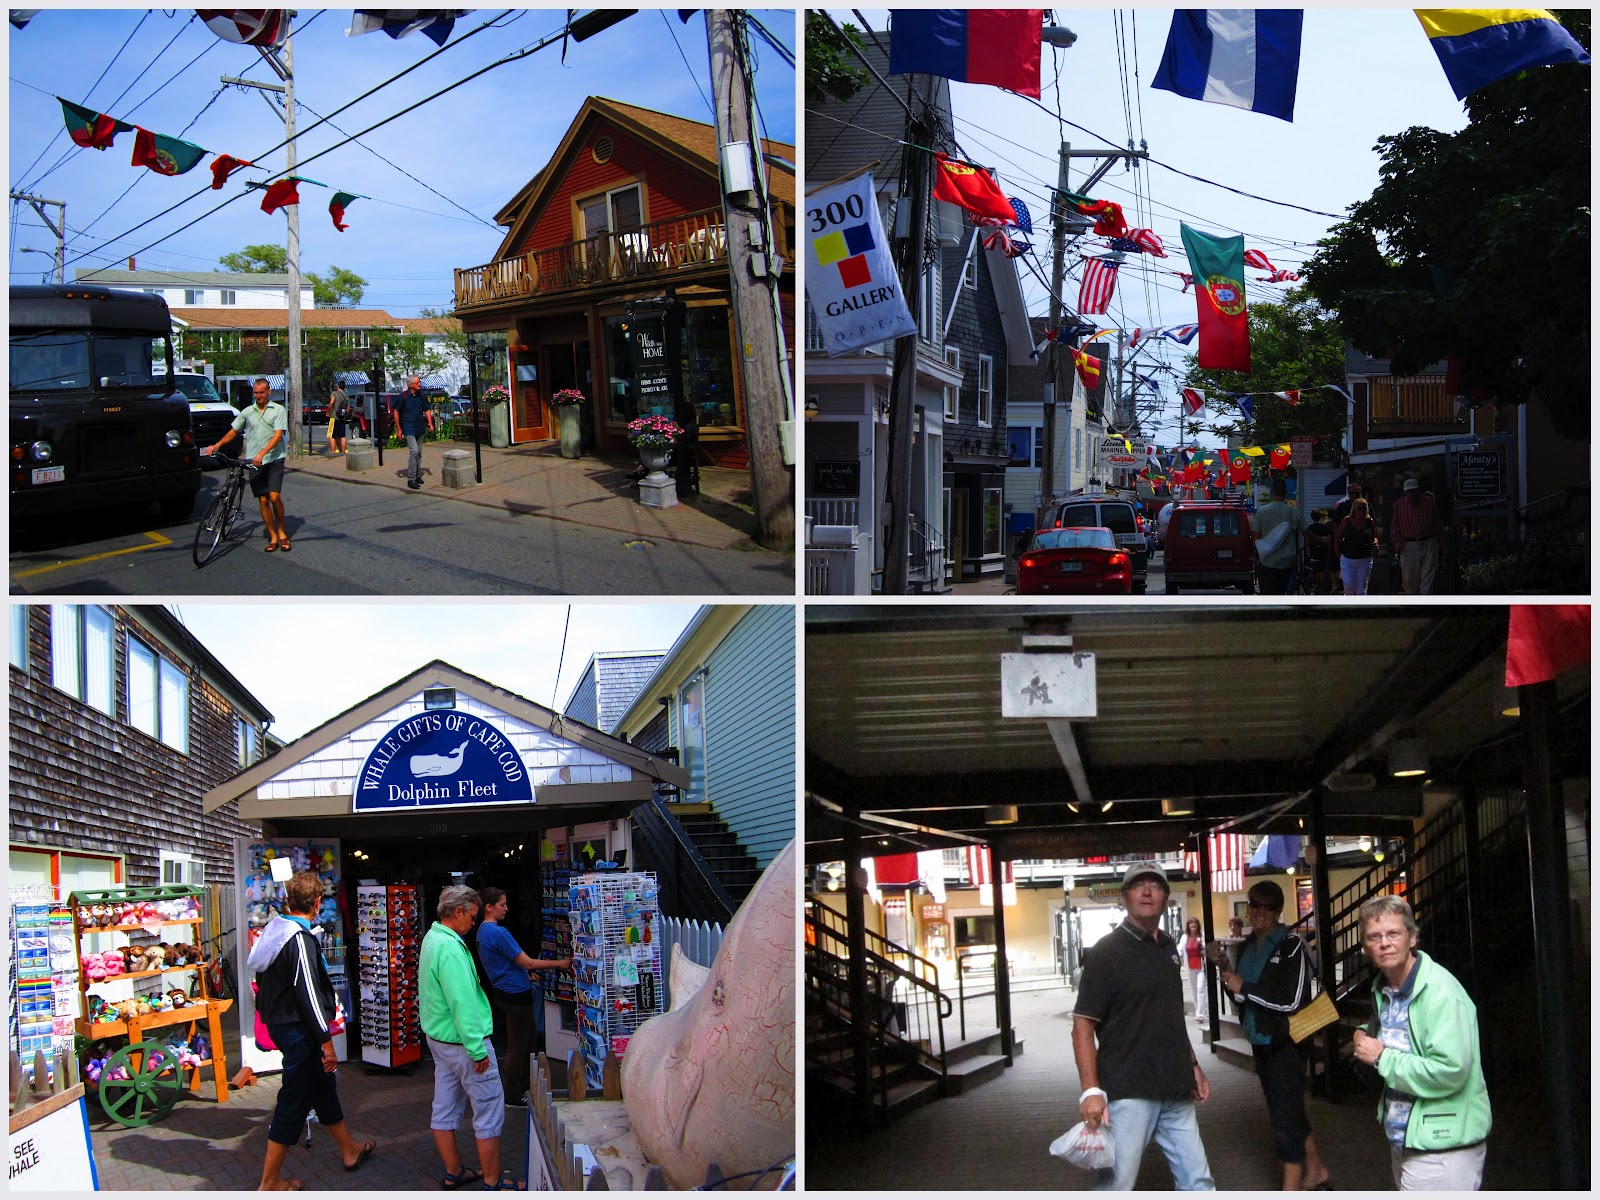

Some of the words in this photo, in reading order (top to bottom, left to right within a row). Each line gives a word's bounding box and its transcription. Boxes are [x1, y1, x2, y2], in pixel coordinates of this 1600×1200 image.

[806, 193, 864, 233] 300
[826, 284, 896, 317] GALLERY
[643, 346, 664, 359] HOME
[1461, 455, 1497, 467] Monty's
[363, 737, 402, 791] WHALE
[397, 714, 442, 743] GIFTS
[445, 714, 467, 732] OF
[468, 720, 506, 755] CAPE
[497, 750, 523, 783] COD
[388, 782, 451, 806] Dolphin
[457, 779, 498, 798] Fleet
[14, 1138, 35, 1160] SEE
